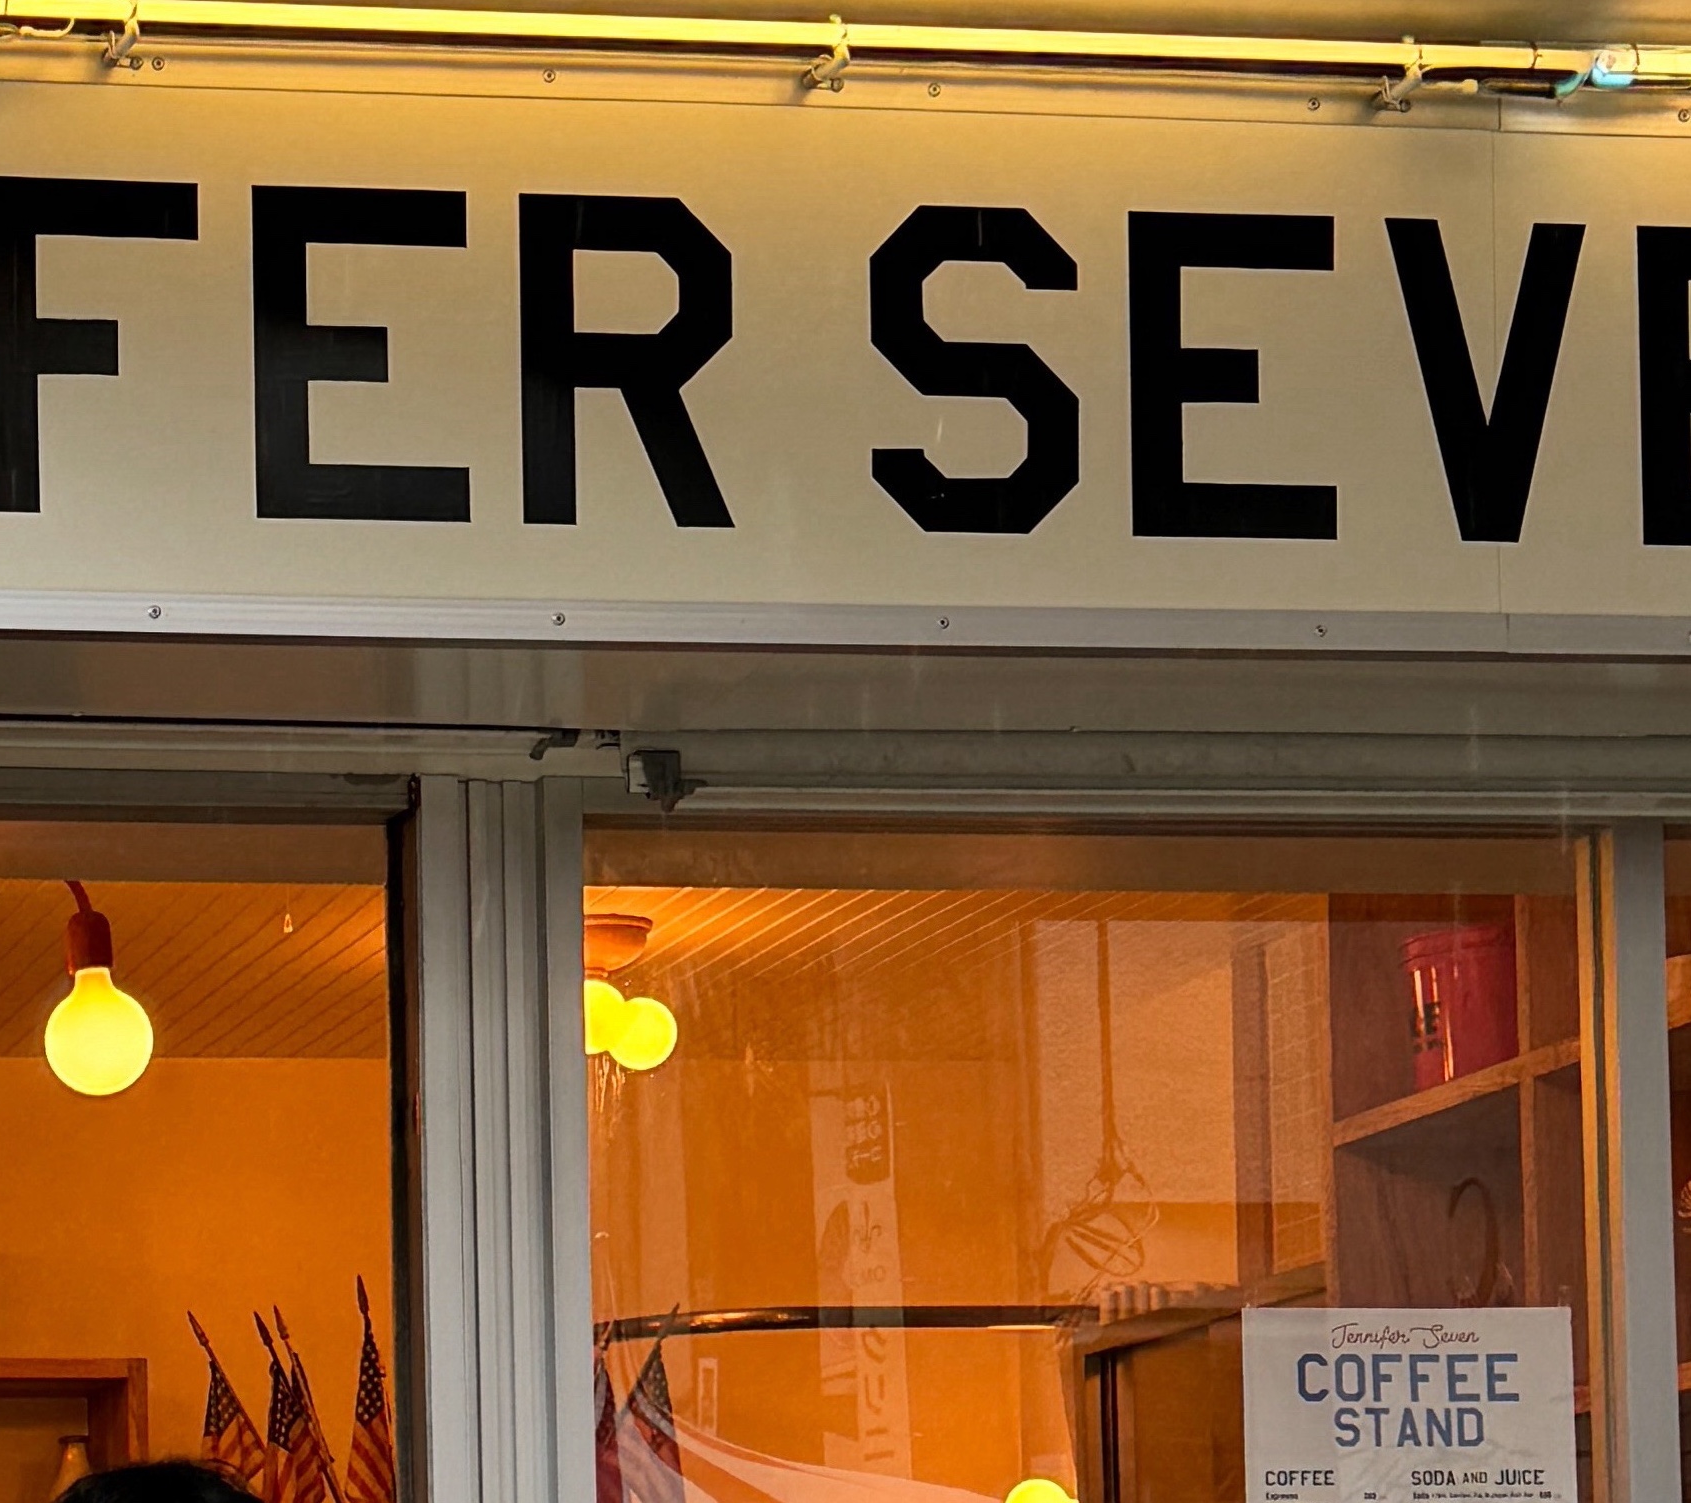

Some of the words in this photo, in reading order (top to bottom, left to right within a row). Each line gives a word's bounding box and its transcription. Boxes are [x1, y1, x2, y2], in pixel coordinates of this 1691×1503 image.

[869, 204, 1691, 546] SEV
[1331, 1322, 1410, 1350] Jennifer
[1409, 1323, 1481, 1349] Seven
[1297, 1353, 1520, 1402] COFFEE
[1334, 1407, 1485, 1447] STAND
[1265, 1470, 1335, 1486] COFFEE
[1411, 1470, 1456, 1486] SODA
[1462, 1471, 1488, 1484] AND
[1494, 1469, 1545, 1486] JUICE
